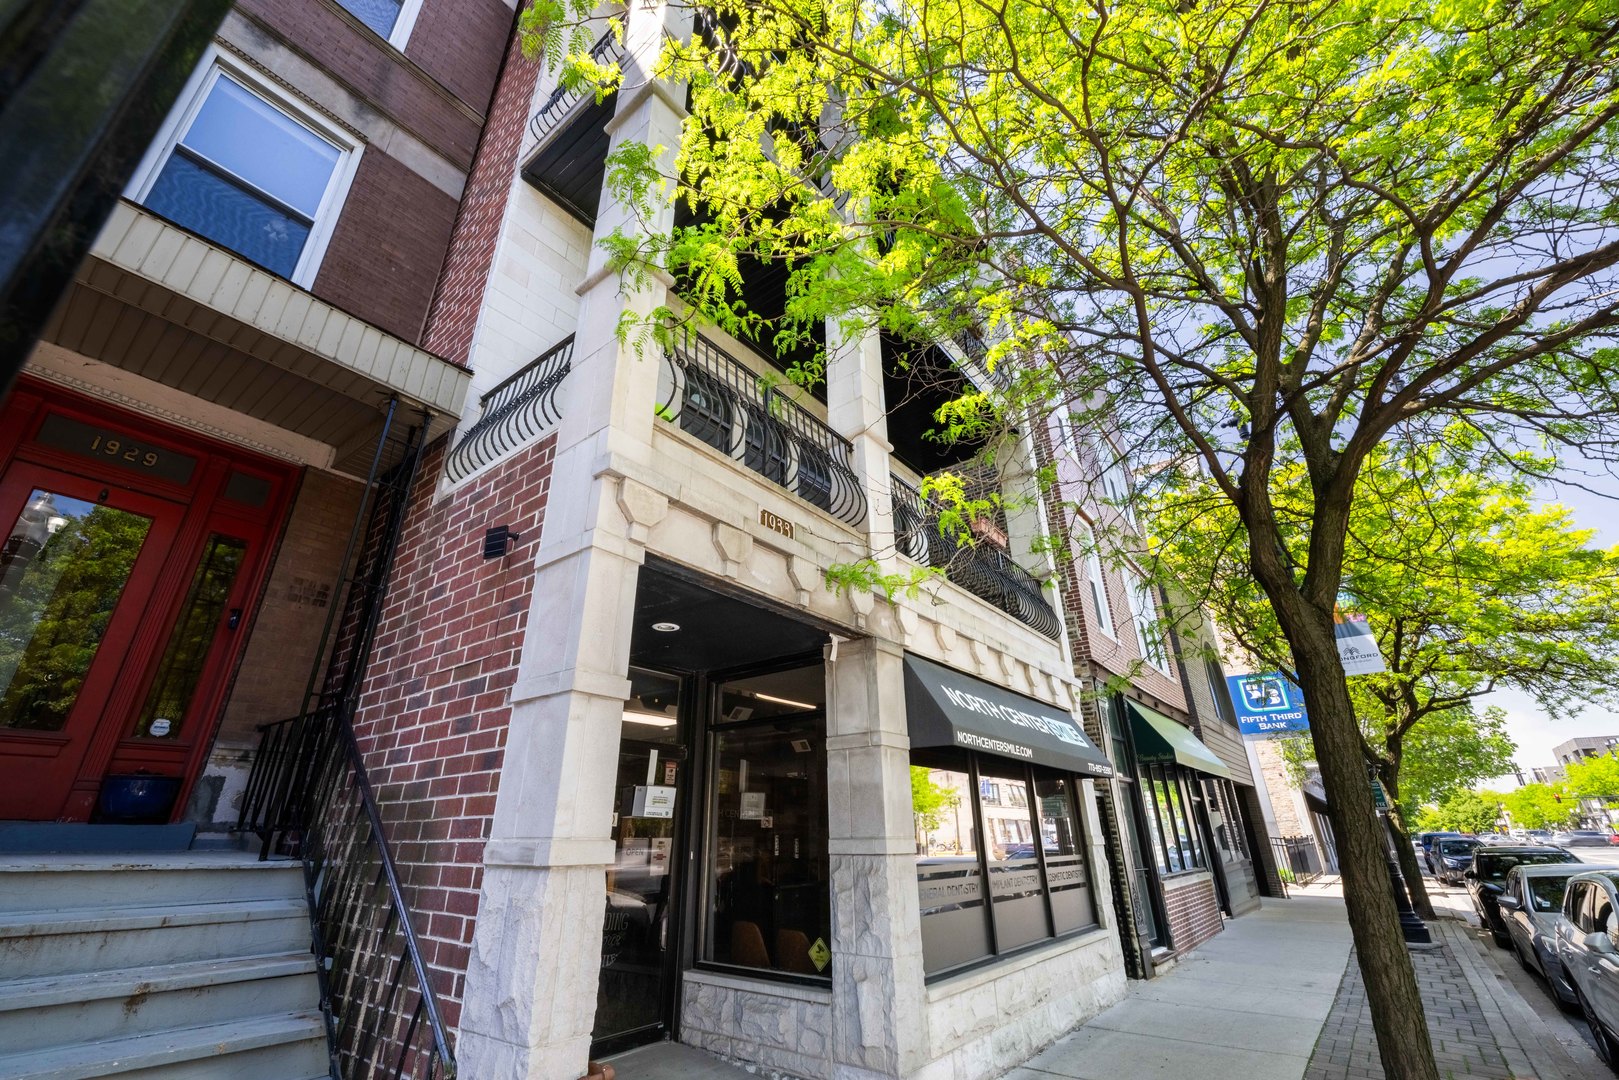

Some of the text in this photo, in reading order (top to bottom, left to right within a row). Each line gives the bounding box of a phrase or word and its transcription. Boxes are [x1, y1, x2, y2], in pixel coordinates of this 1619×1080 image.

[91, 435, 159, 467] 1929
[940, 684, 1006, 721] NORTH
[999, 704, 1056, 736] CENTER
[1240, 712, 1302, 724] FIFTH THIRD
[1258, 721, 1288, 730] BANK
[956, 730, 1033, 759] NORTHCENTERSMILE.COM
[625, 847, 645, 857] OPEN
